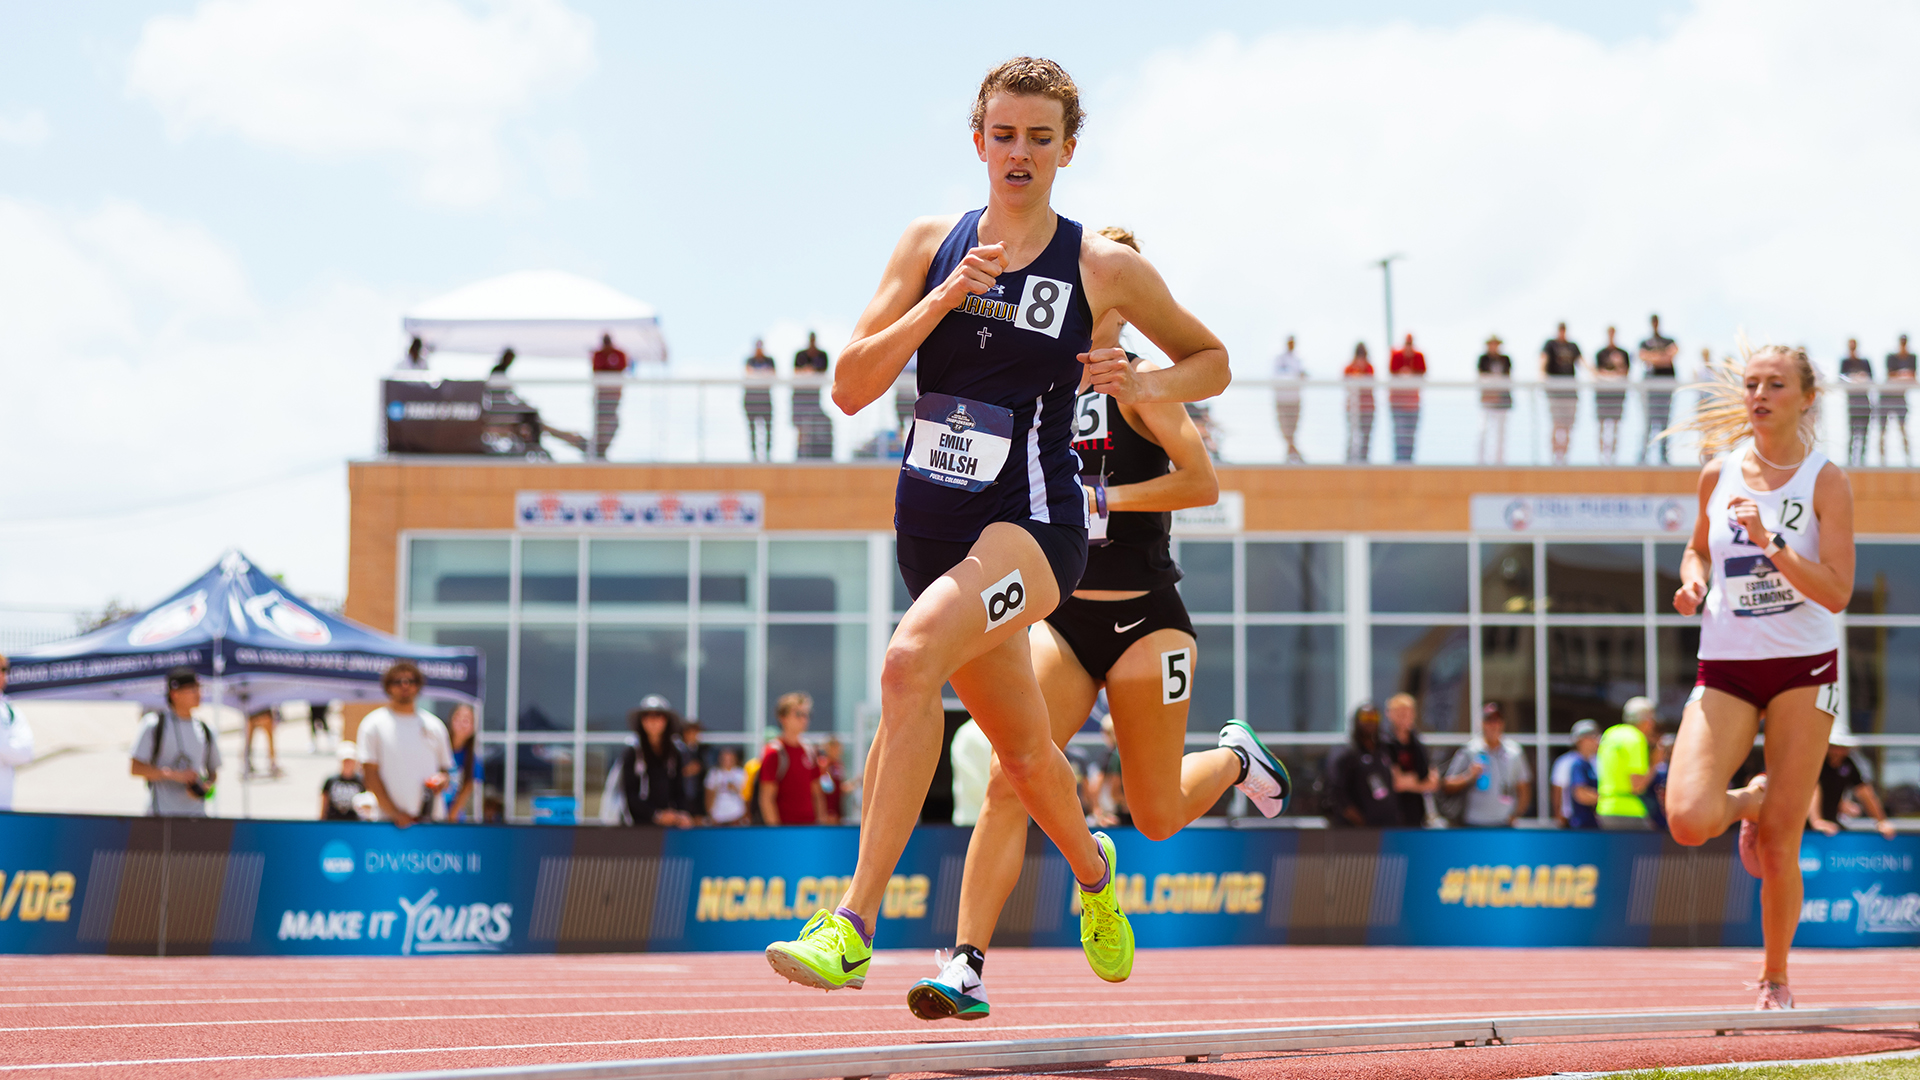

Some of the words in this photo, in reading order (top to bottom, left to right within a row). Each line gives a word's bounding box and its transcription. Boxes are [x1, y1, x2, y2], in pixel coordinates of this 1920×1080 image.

[1025, 280, 1060, 330] 8
[1078, 393, 1100, 437] 5
[939, 433, 973, 453] EMILY
[929, 449, 978, 476] WALSH
[1779, 499, 1804, 531] 12
[988, 582, 1024, 623] 8
[1739, 589, 1795, 607] CLEMONS
[1746, 579, 1782, 592] ESTELLA
[1167, 652, 1187, 700] 5
[365, 849, 463, 874] DIVISION
[1438, 864, 1599, 909] #NCAAD2
[279, 909, 366, 941] MAKE
[368, 909, 398, 940] IT
[398, 887, 513, 956] YOURS
